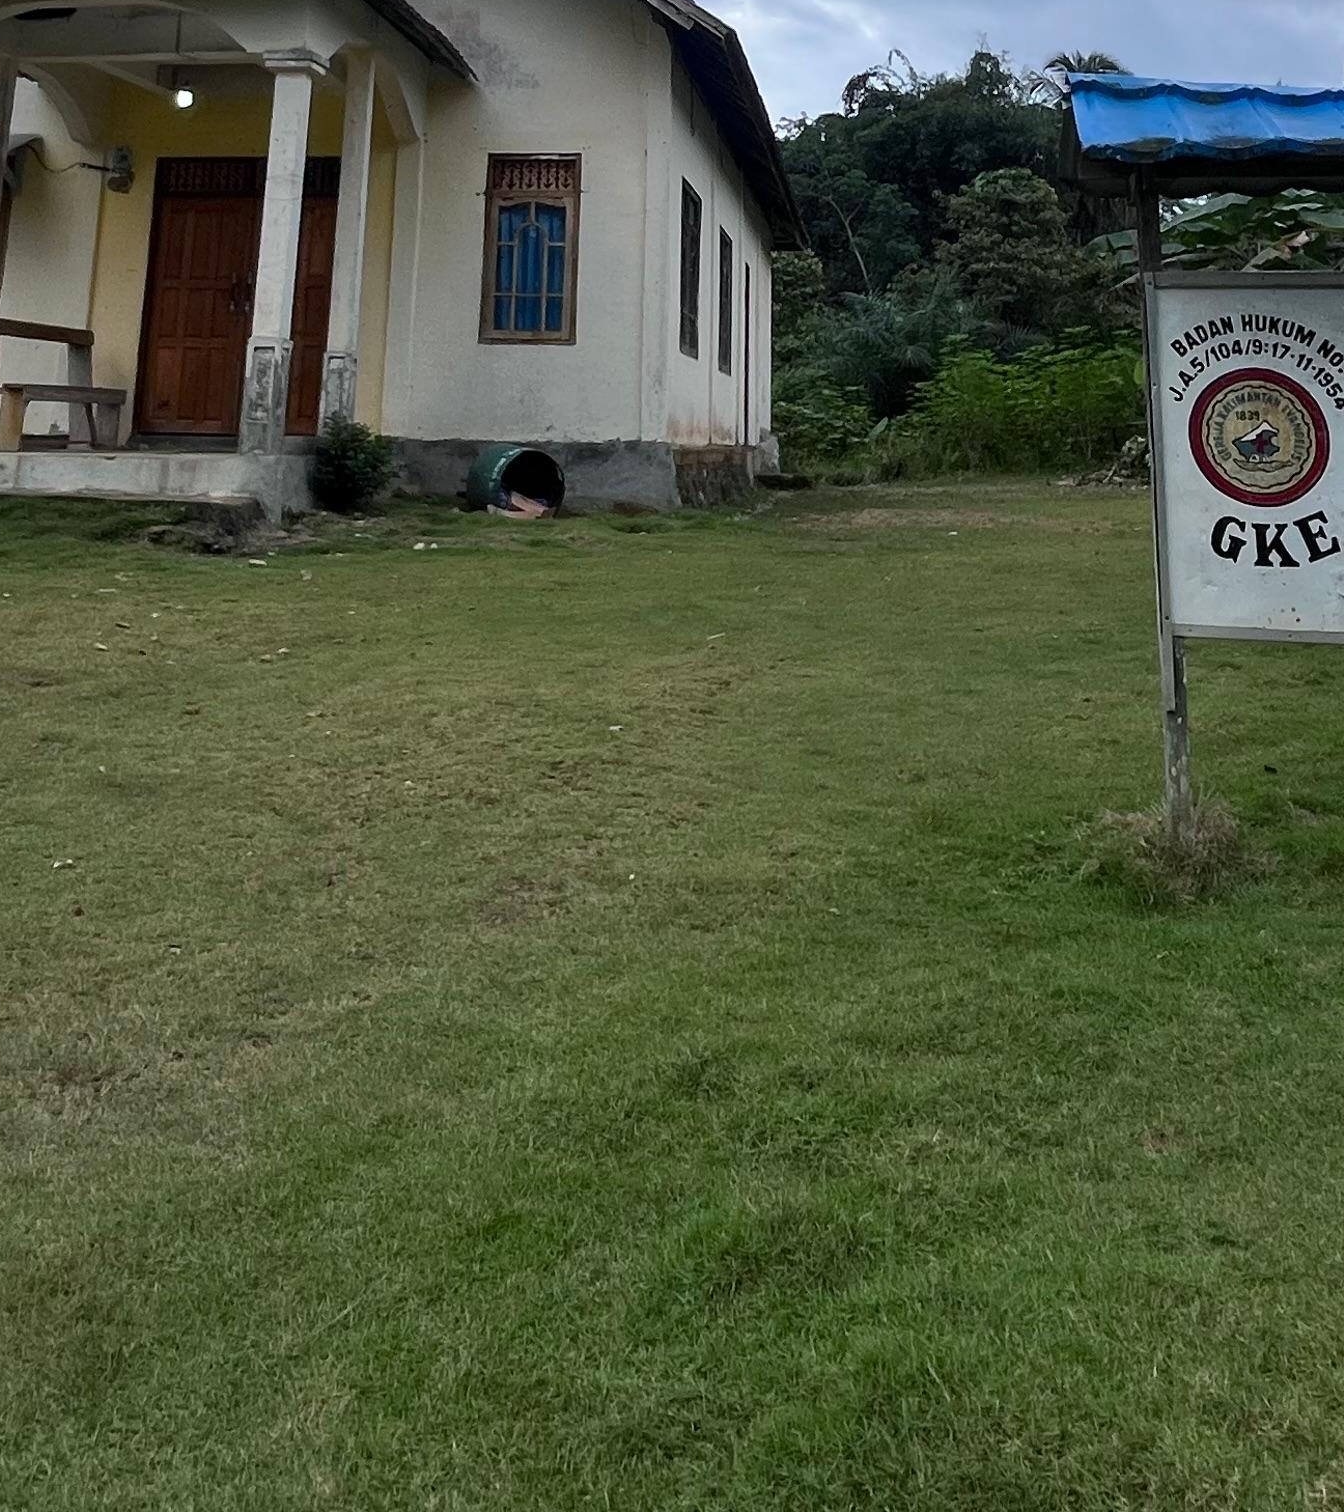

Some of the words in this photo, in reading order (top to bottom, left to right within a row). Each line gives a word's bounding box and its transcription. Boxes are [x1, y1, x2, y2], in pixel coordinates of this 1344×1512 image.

[1170, 316, 1234, 358] BADAN
[1241, 314, 1316, 347] HUKUM
[1211, 511, 1341, 567] GKE
